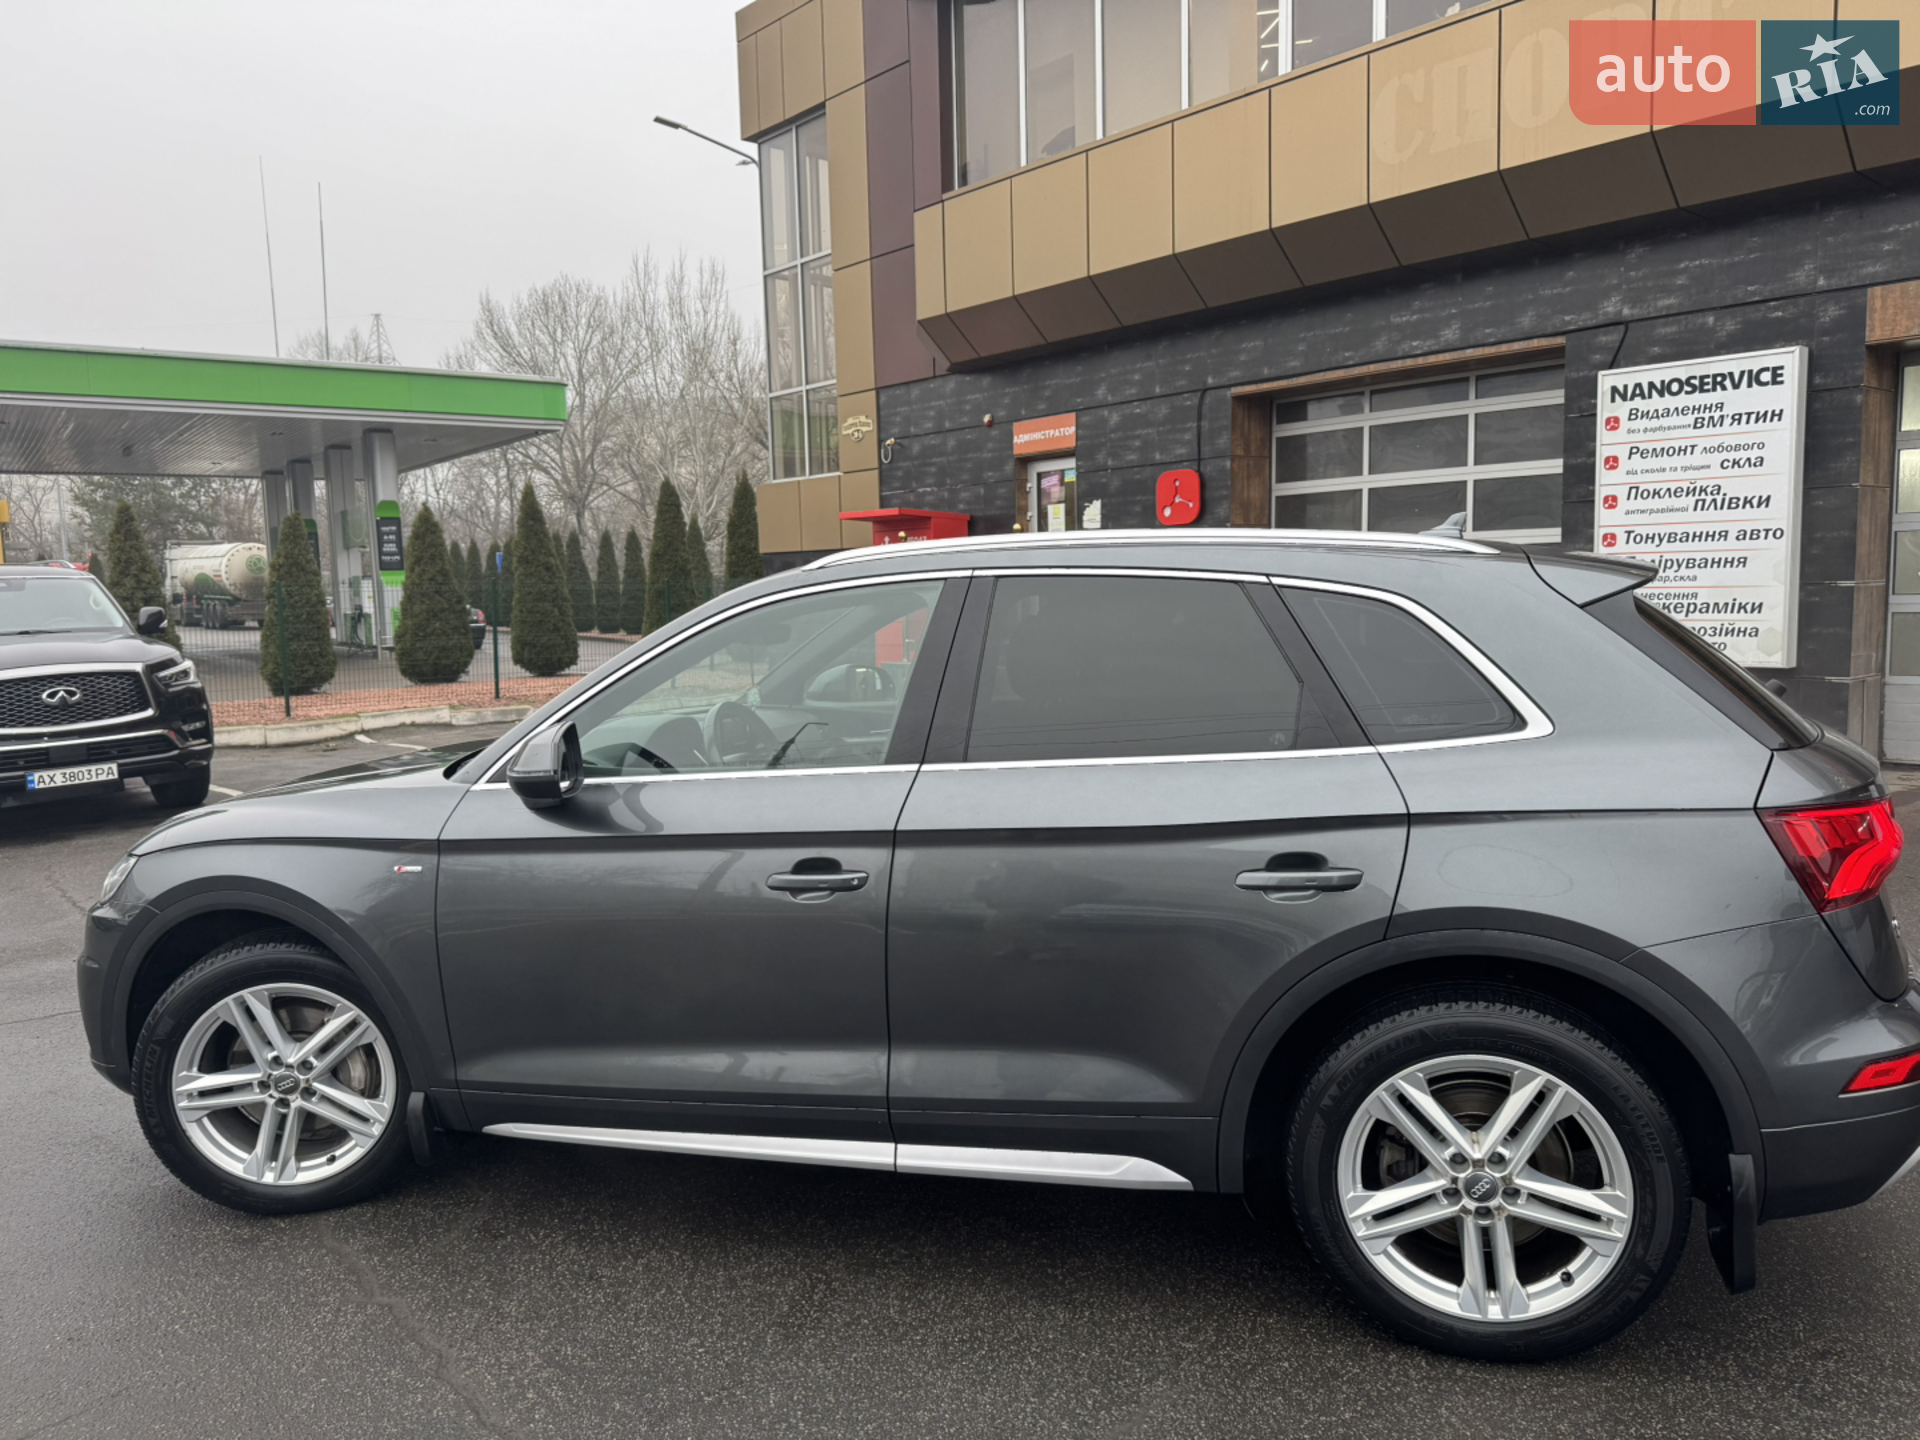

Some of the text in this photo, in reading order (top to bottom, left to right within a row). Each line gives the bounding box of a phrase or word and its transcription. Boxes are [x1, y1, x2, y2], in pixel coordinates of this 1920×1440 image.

[1610, 365, 1785, 403] NANOSERVICE
[1627, 402, 1725, 421] Видалення
[1013, 426, 1076, 444] АДМІНІСТРАТОР
[1628, 441, 1766, 460] Ремонт лобового
[1720, 455, 1764, 470] скла
[1626, 481, 1722, 501] Поклейка
[1693, 492, 1772, 512] плівки
[1624, 527, 1785, 547] Тонування авто
[1662, 598, 1764, 617] кераміки
[37, 766, 116, 787] AX 3803 PA
[1336, 1033, 1417, 1093] MICHELIN
[143, 1046, 159, 1119] MICHELIN
[1612, 1084, 1666, 1164] LATITUDE
